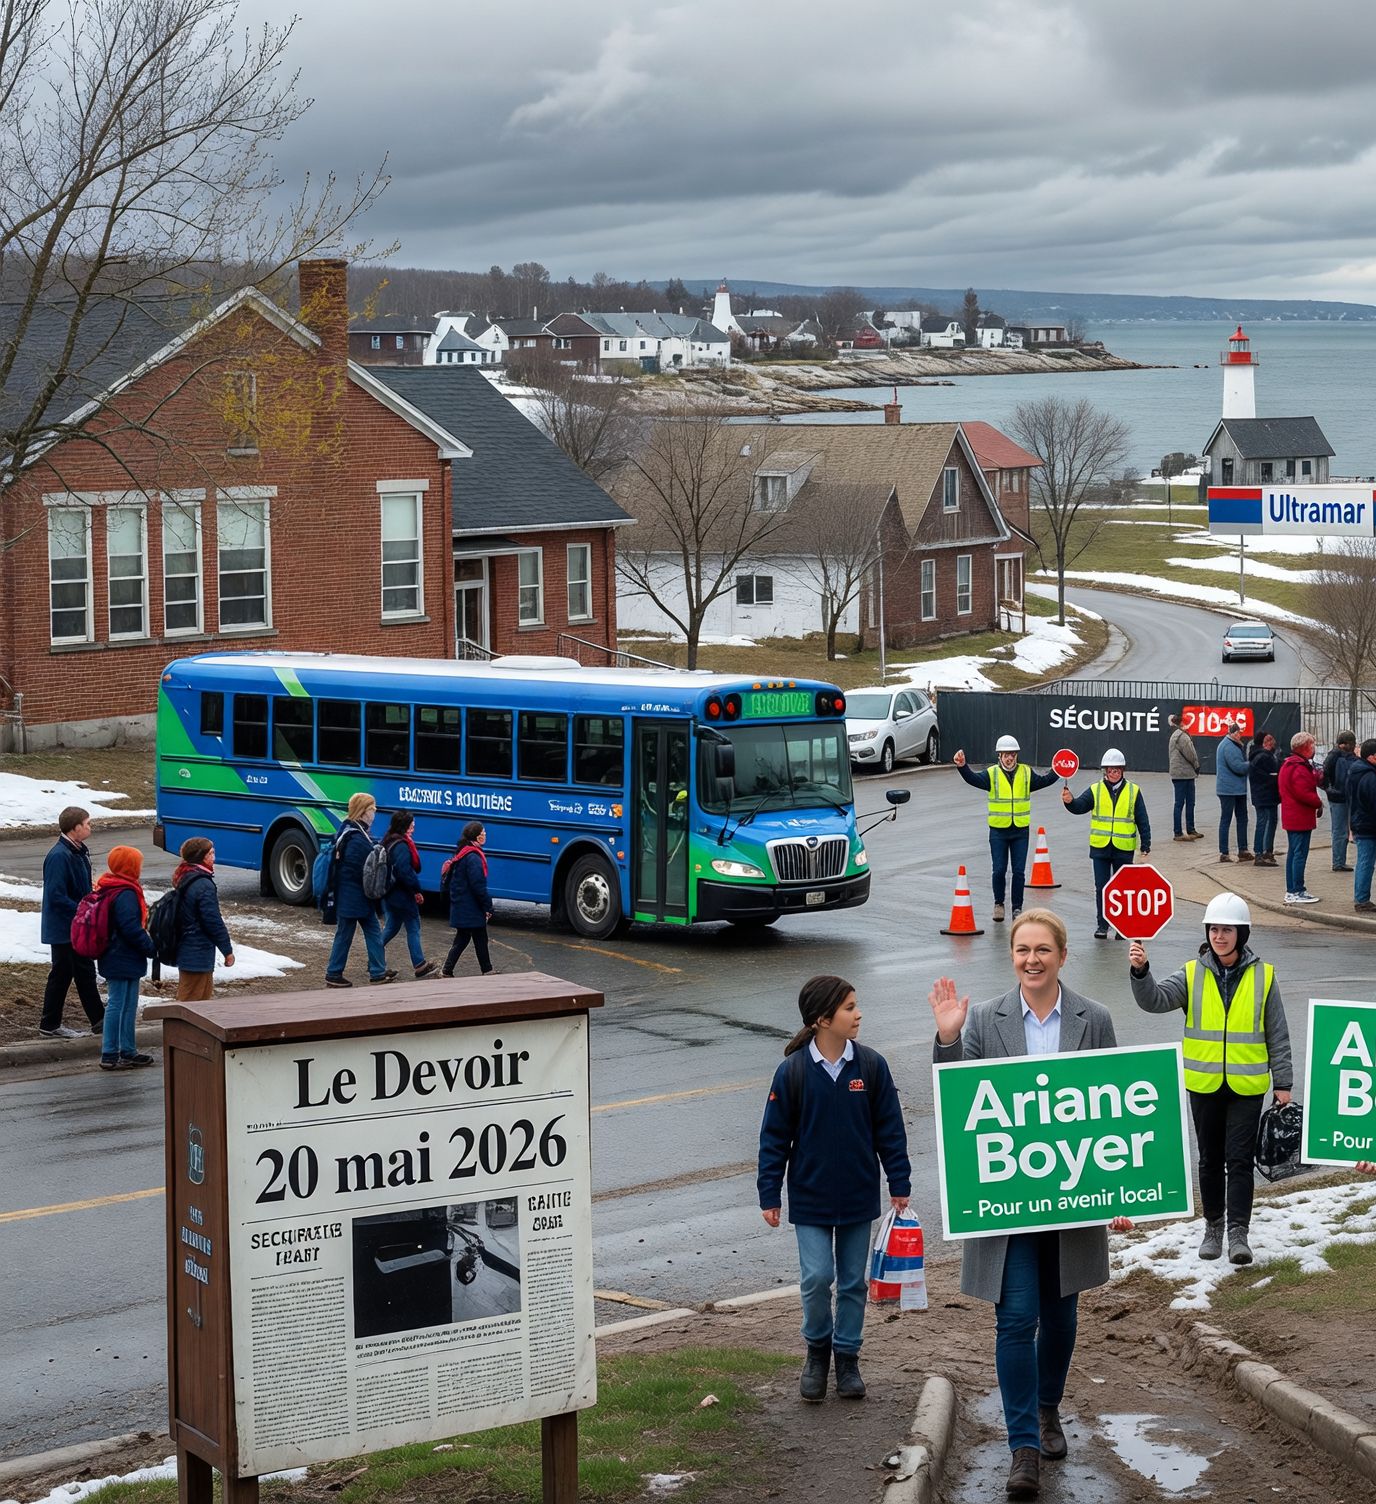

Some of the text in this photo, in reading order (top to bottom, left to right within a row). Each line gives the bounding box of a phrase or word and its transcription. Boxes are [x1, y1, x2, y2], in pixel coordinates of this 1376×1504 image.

[1269, 493, 1366, 524] Ultramar
[1049, 705, 1160, 732] SÉCURITÉ
[1108, 888, 1167, 917] STOP
[293, 1038, 529, 1109] Le Devoir
[963, 1073, 1159, 1132] Ariane
[1332, 1130, 1374, 1149] Pour
[255, 1145, 319, 1204] 20
[335, 1130, 433, 1194] mai
[449, 1113, 567, 1180] 2026
[976, 1130, 1155, 1191] Boyer
[978, 1199, 1023, 1218] Pour
[1028, 1198, 1052, 1213] un
[1057, 1191, 1112, 1209] avenir
[1119, 1182, 1163, 1204] local
